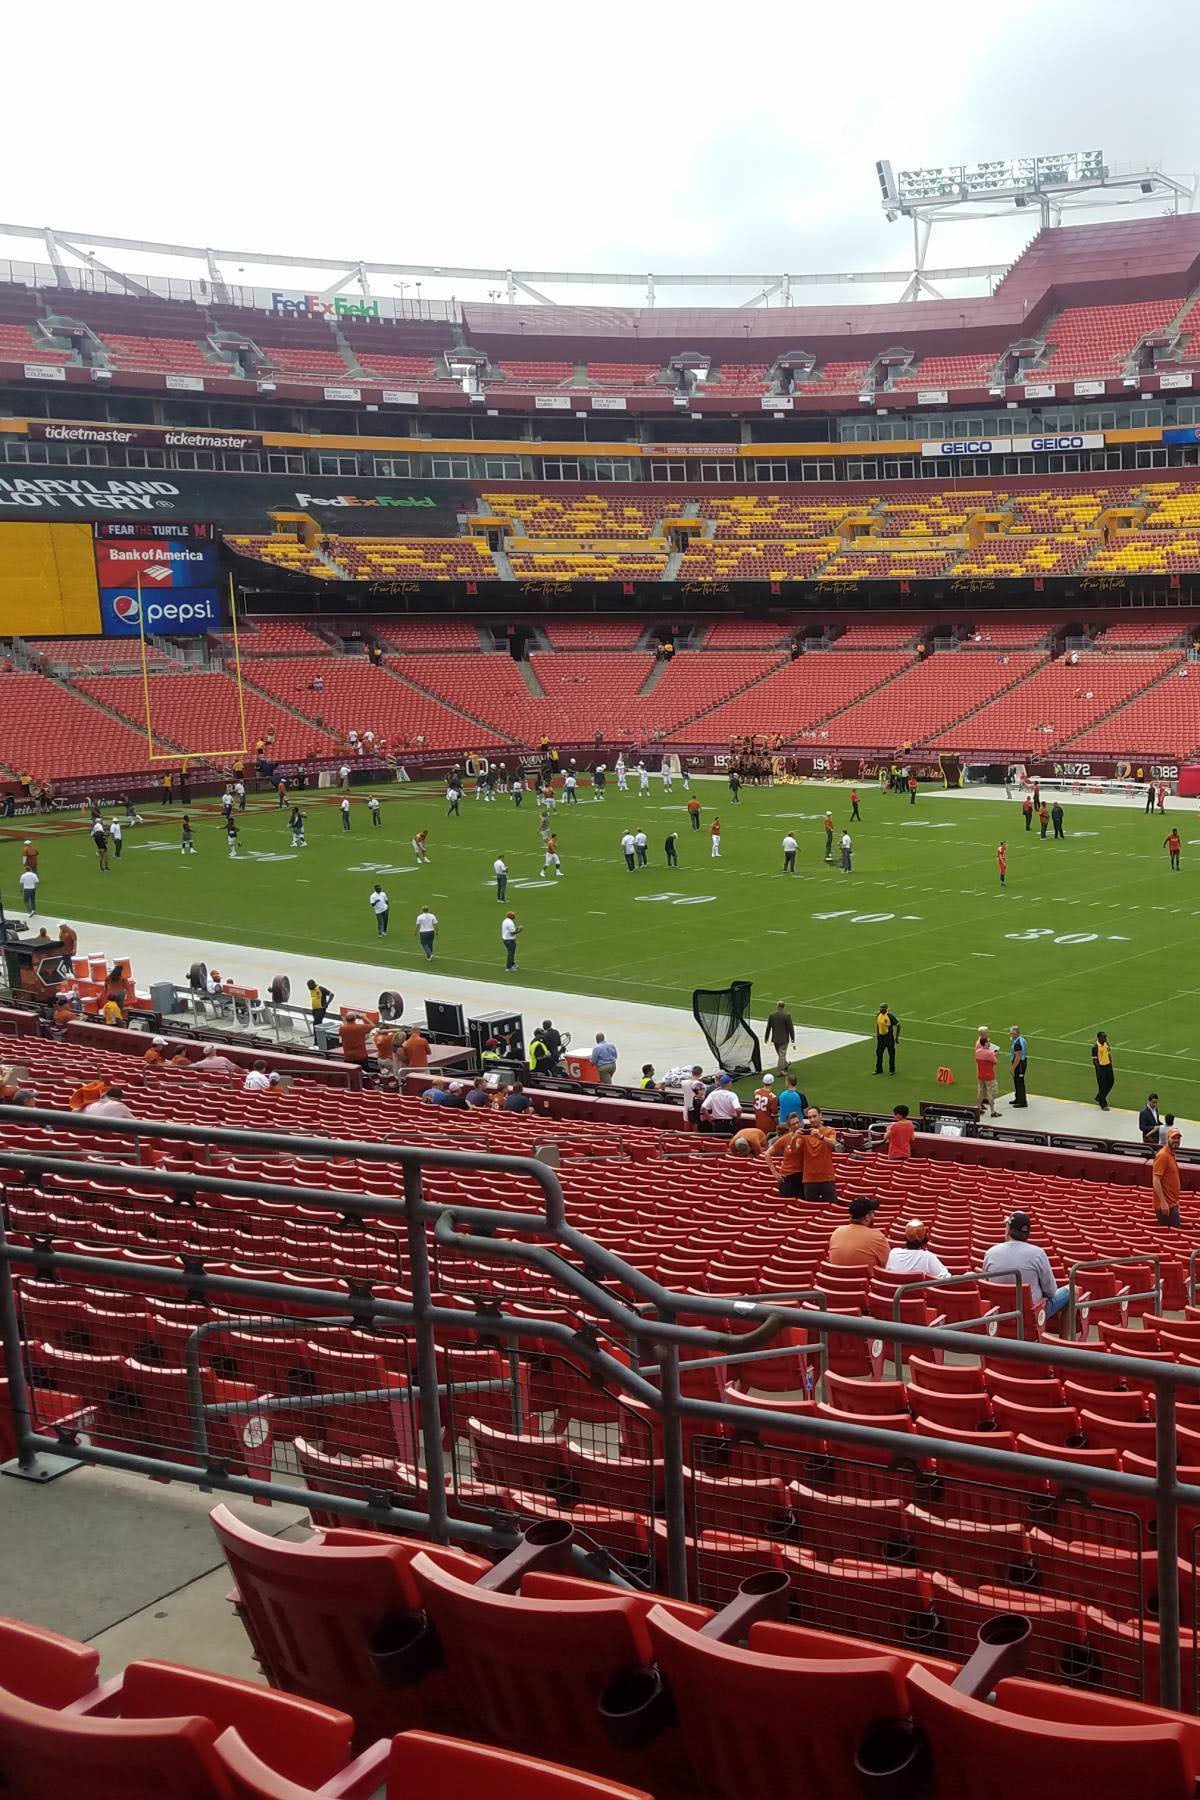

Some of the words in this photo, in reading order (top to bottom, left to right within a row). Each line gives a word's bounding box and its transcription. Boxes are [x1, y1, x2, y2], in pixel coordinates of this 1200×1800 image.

[272, 292, 379, 317] FedExField
[45, 425, 132, 443] ticketmaster
[165, 432, 247, 449] ticketmaster
[1031, 437, 1083, 450] GEICO
[941, 441, 992, 454] GEICO
[295, 493, 437, 508] FedExField
[109, 548, 136, 561] Bank
[141, 548, 156, 561] of
[156, 548, 203, 561] America
[148, 600, 211, 624] pepsi
[347, 863, 420, 874] 30
[634, 891, 718, 905] 50
[812, 909, 896, 924] 40
[1005, 927, 1098, 945] 30
[937, 1068, 949, 1083] 20
[754, 1094, 769, 1112] 32
